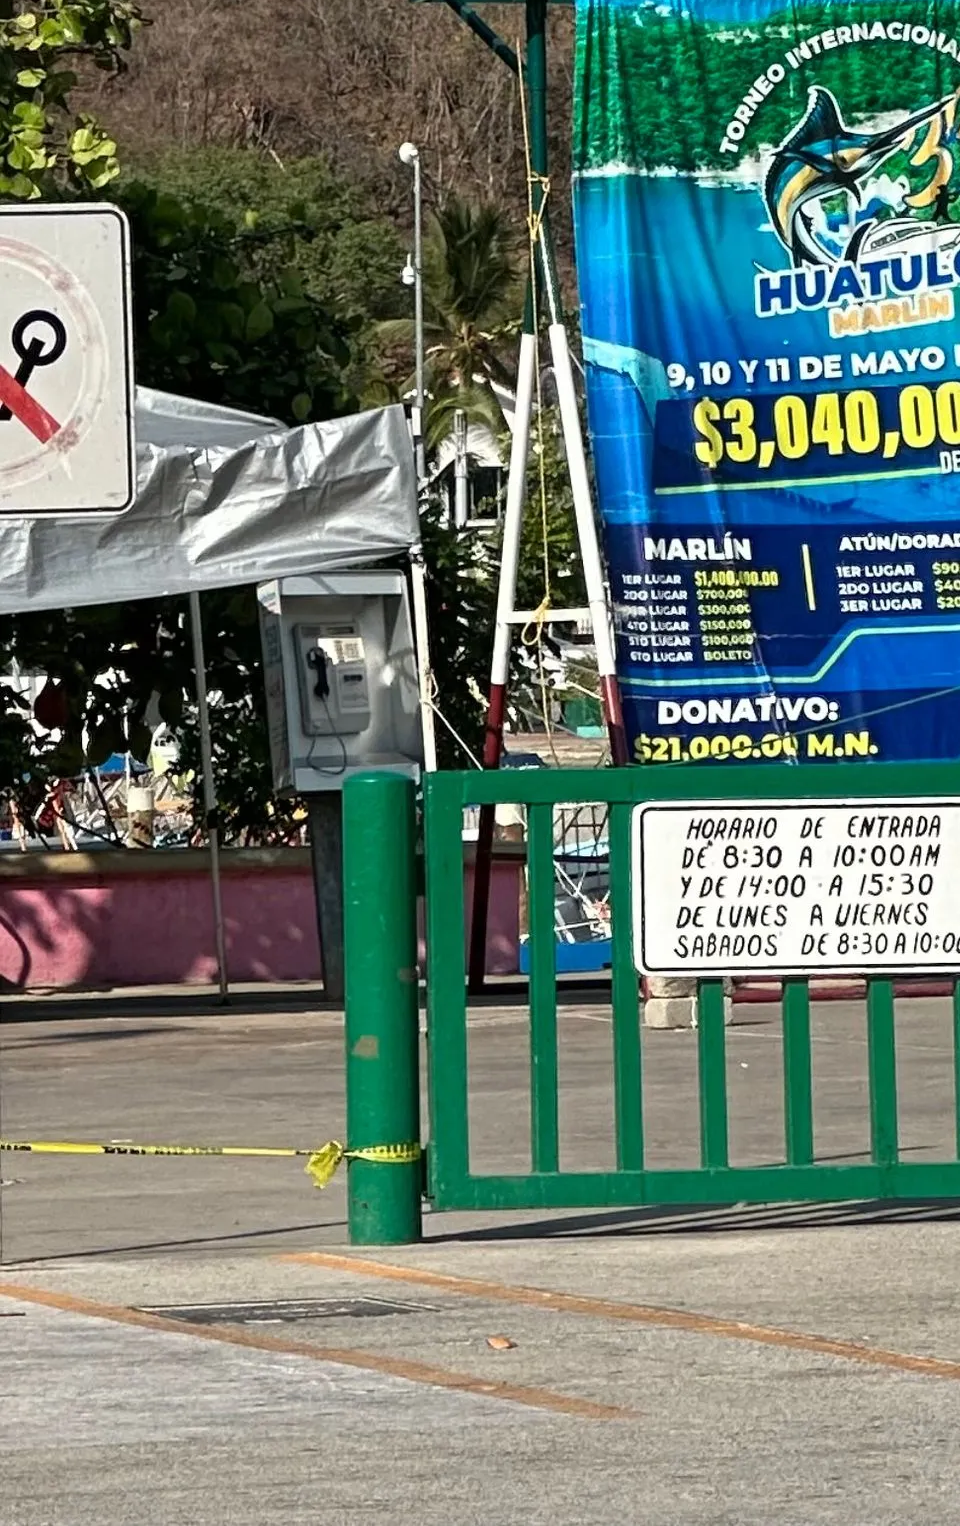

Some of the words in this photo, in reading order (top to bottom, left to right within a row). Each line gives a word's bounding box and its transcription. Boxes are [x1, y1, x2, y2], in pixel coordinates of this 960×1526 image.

[719, 63, 786, 155] TORNEO
[667, 362, 696, 391] 9,
[700, 361, 731, 386] 10
[738, 359, 759, 384] Y
[765, 357, 791, 383] 11
[800, 354, 843, 381] DE
[850, 346, 945, 376] MAYO
[643, 530, 753, 561] MARLÍN
[644, 574, 682, 585] LUGAR
[836, 565, 862, 578] 1ER
[864, 564, 916, 578] LUGAR
[651, 589, 688, 601] LUGAR
[838, 582, 869, 596] 2DO
[872, 580, 924, 595] LUGAR
[648, 604, 687, 616] LUGAR
[840, 599, 869, 613] 3ER
[871, 598, 923, 612] LUGAR
[627, 621, 648, 632] 4TO
[650, 620, 690, 632] LUGAR
[651, 634, 691, 647] LUGAR
[630, 650, 651, 662] 6TO
[653, 650, 693, 662] LUGAR
[704, 649, 752, 661] BOLETO
[658, 696, 840, 725] DONATIVO:
[807, 730, 879, 758] M.N.
[686, 817, 777, 840] HORARIO
[800, 816, 824, 839] DE
[847, 814, 942, 838] ENTRADA
[682, 847, 706, 869] DE
[722, 845, 783, 869] 8:30
[799, 846, 813, 868] A
[681, 875, 693, 898] Y
[699, 875, 728, 898] DE
[737, 874, 807, 898] 14:00
[828, 874, 843, 897] A
[859, 873, 934, 897] 15:30
[676, 906, 706, 929] DE
[716, 905, 788, 928] LUNES
[810, 904, 824, 927] A
[673, 933, 778, 959] SABADOS
[801, 933, 829, 956] DE
[836, 932, 889, 955] 8:30
[894, 931, 907, 954] A
